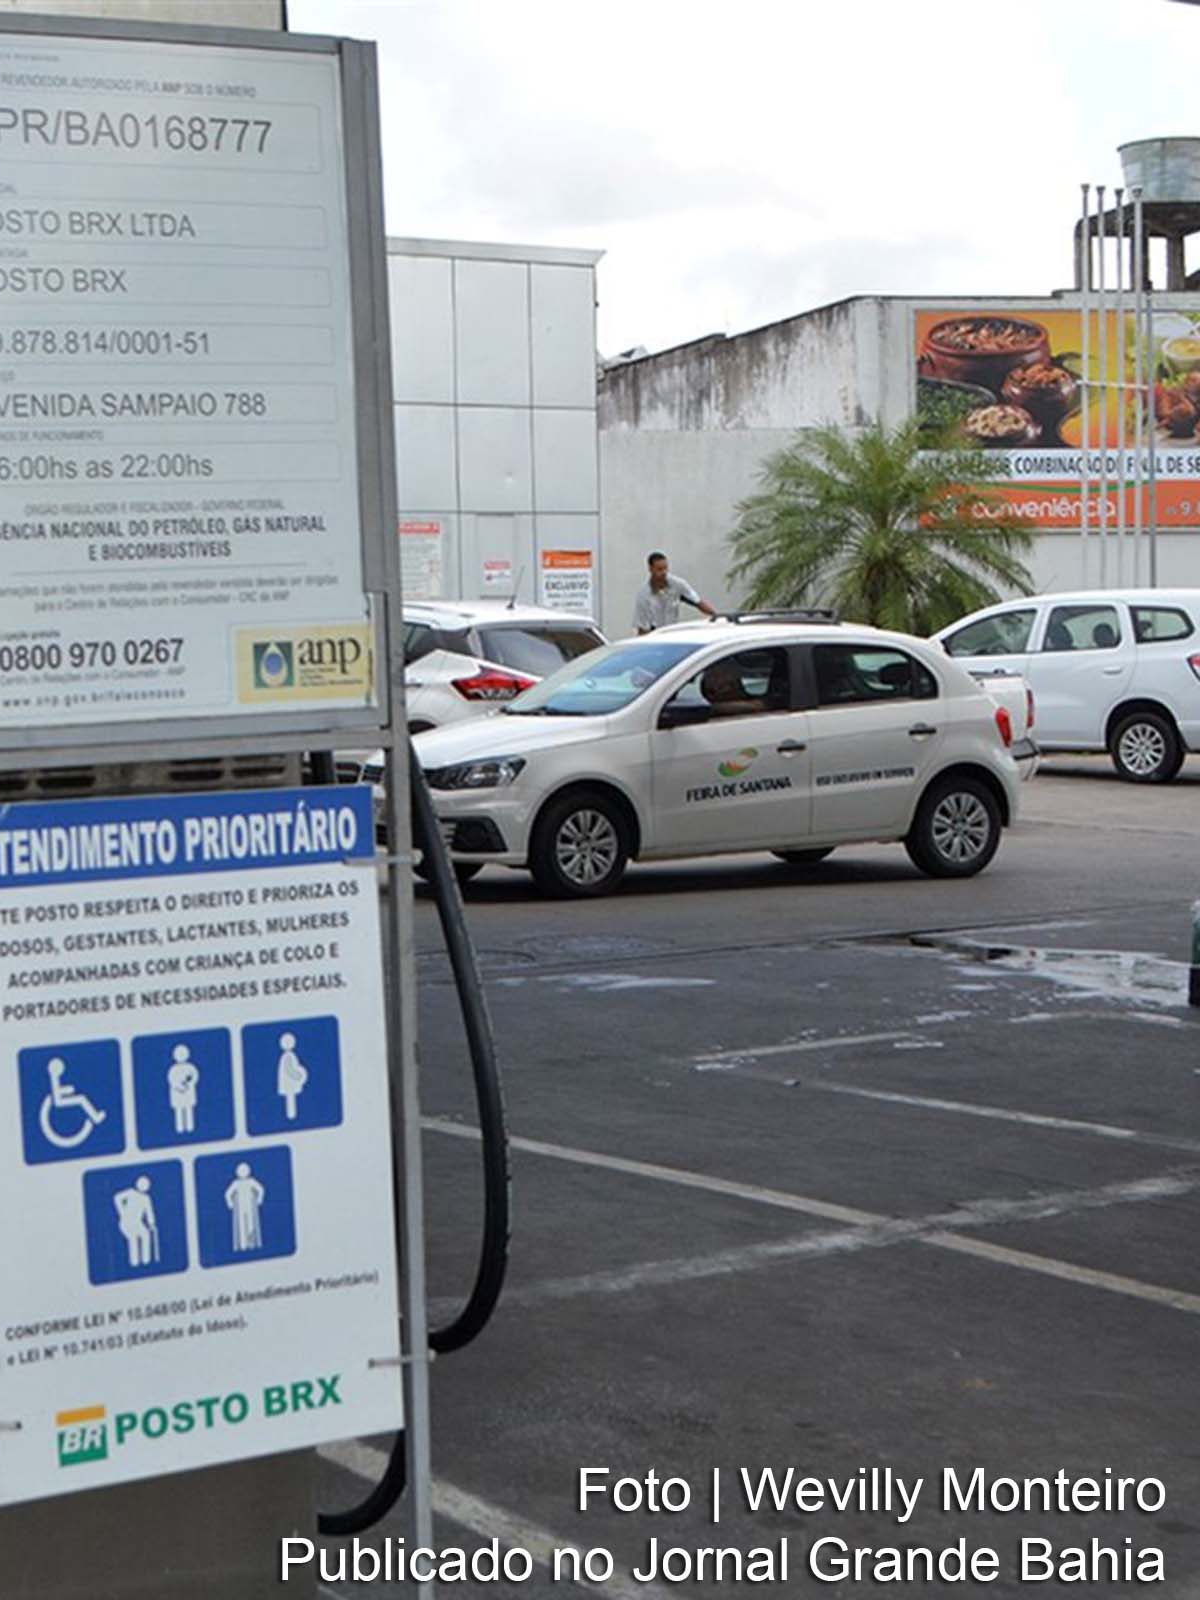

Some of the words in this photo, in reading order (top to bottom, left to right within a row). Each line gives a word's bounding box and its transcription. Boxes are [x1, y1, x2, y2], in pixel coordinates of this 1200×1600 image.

[70, 210, 124, 236] BRX
[130, 213, 196, 237] LTDA
[73, 269, 128, 293] BRX
[100, 392, 217, 417] SAMPAIO
[225, 392, 267, 415] 788
[85, 459, 113, 479] as
[121, 453, 213, 478] 22:00hs
[971, 496, 1116, 518] conveniênca
[50, 520, 124, 538] NACIONAL
[128, 518, 149, 537] DO
[265, 515, 327, 532] NATURAL
[88, 544, 97, 561] E
[69, 641, 116, 668] 970
[123, 637, 184, 666] 0267
[298, 637, 361, 675] anp
[686, 786, 721, 802] FEIRA
[722, 783, 737, 797] DE
[740, 776, 792, 794] SANTANA
[185, 801, 357, 861] PRIORITÁRIO
[25, 904, 79, 924] POSTO
[83, 897, 160, 919] RESPEITA
[165, 895, 176, 912] O
[181, 890, 245, 911] DIREITO
[249, 888, 258, 904] E
[263, 882, 334, 903] PRIORIZA
[339, 880, 359, 896] OS
[64, 929, 163, 952] GESTANTES,
[167, 920, 261, 944] LACTANTES,
[266, 911, 350, 934] MULHERES
[7, 962, 141, 989] ACOMPANHADAS
[146, 957, 181, 975] COM
[185, 951, 255, 974] CRIANÇA
[259, 949, 280, 965] DE
[284, 944, 326, 963] COLO
[329, 943, 340, 958] E
[3, 997, 111, 1021] PORTADORES
[115, 993, 137, 1010] DE
[140, 981, 259, 1008] NECESSIDADES
[263, 973, 347, 996] ESPECIAIS.
[5, 1317, 80, 1341] CONFORME
[83, 1312, 105, 1328] LEI
[217, 1293, 231, 1307] de
[235, 1281, 312, 1302] Atendimento
[7, 1356, 15, 1366] e
[18, 1348, 40, 1364] LEI
[127, 1326, 184, 1350] (Estatuto
[188, 1323, 203, 1336] do
[61, 1426, 103, 1456] BR
[115, 1392, 249, 1444] POSTO
[263, 1374, 342, 1417] BRX
